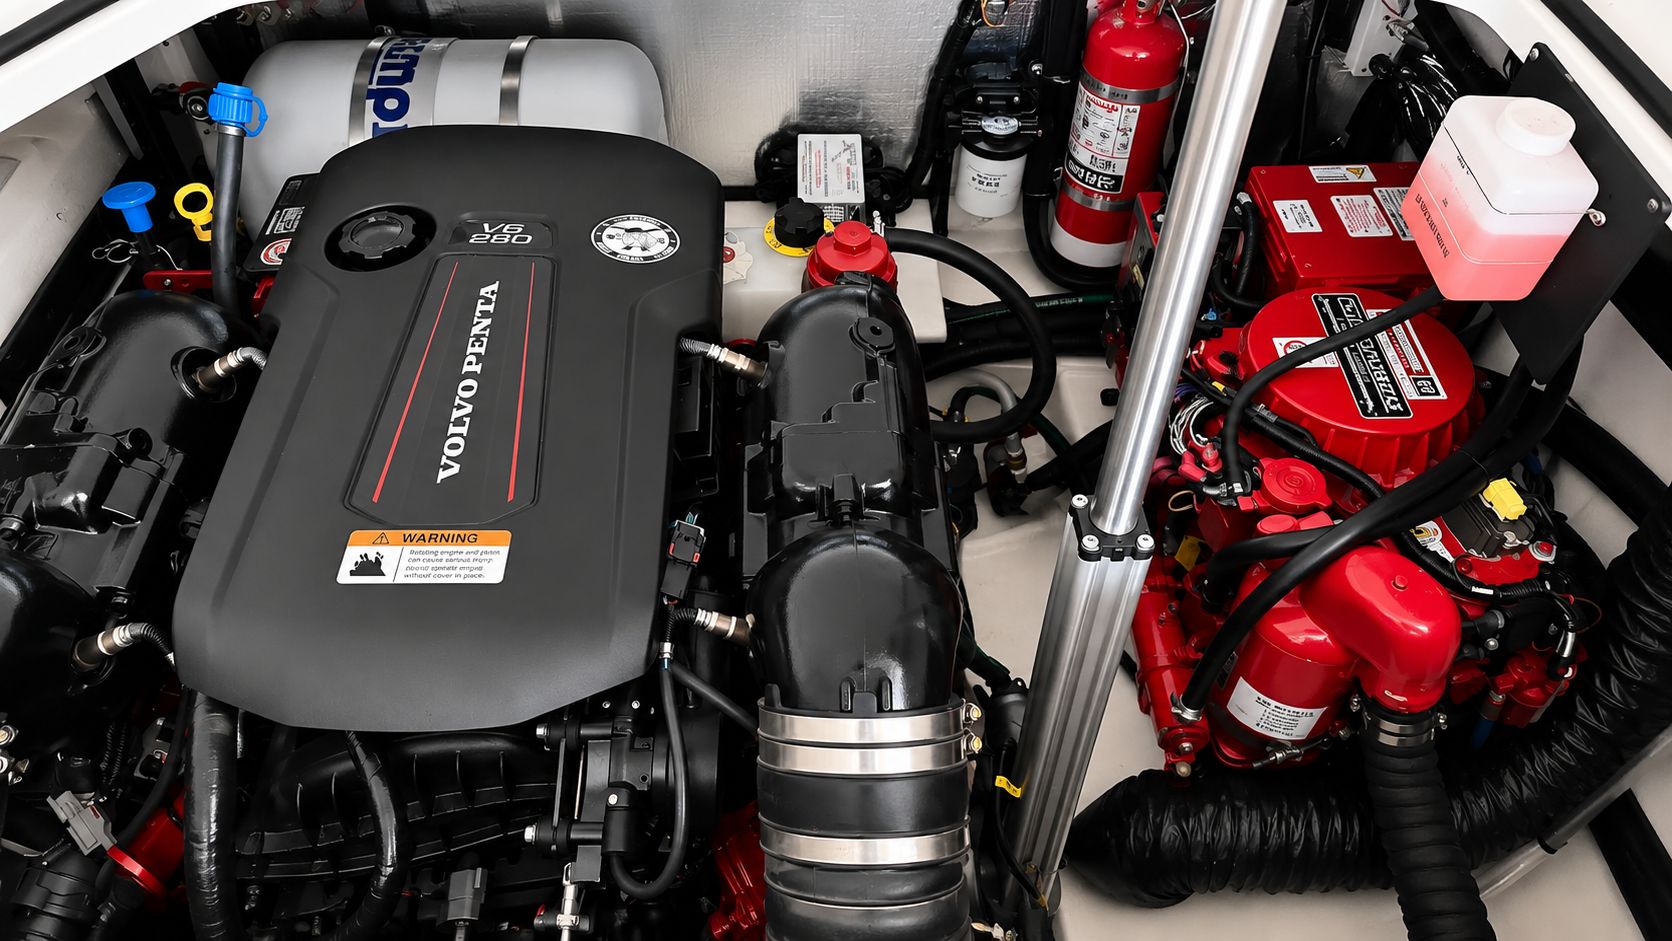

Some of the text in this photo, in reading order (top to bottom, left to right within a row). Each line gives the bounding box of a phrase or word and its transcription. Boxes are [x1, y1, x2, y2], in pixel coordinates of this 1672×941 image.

[483, 223, 525, 234] V6
[468, 233, 533, 244] 280
[436, 280, 500, 484] VOLVO PENTA
[402, 533, 478, 544] WARNING
